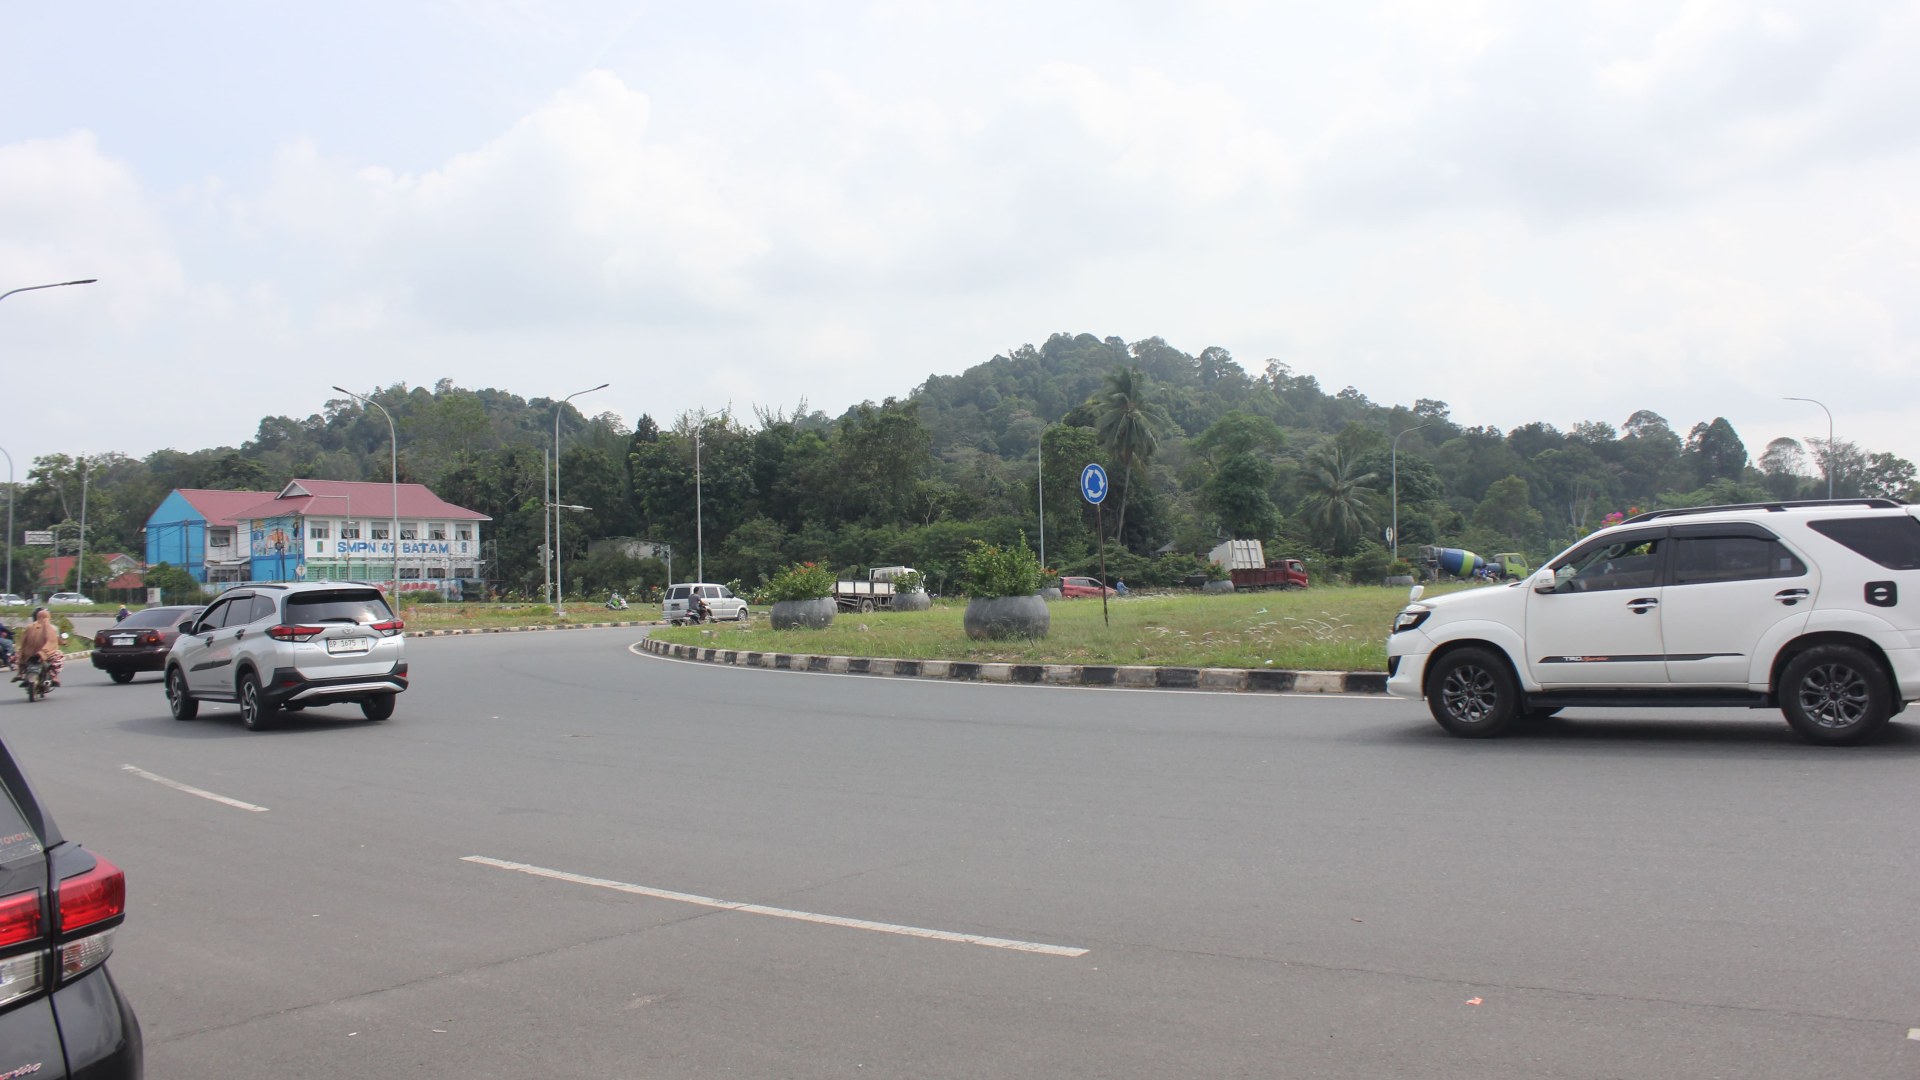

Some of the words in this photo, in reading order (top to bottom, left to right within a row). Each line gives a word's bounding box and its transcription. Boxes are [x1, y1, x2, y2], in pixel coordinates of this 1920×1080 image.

[337, 541, 376, 553] SMPN
[381, 542, 395, 553] 47
[402, 543, 449, 554] BATAM
